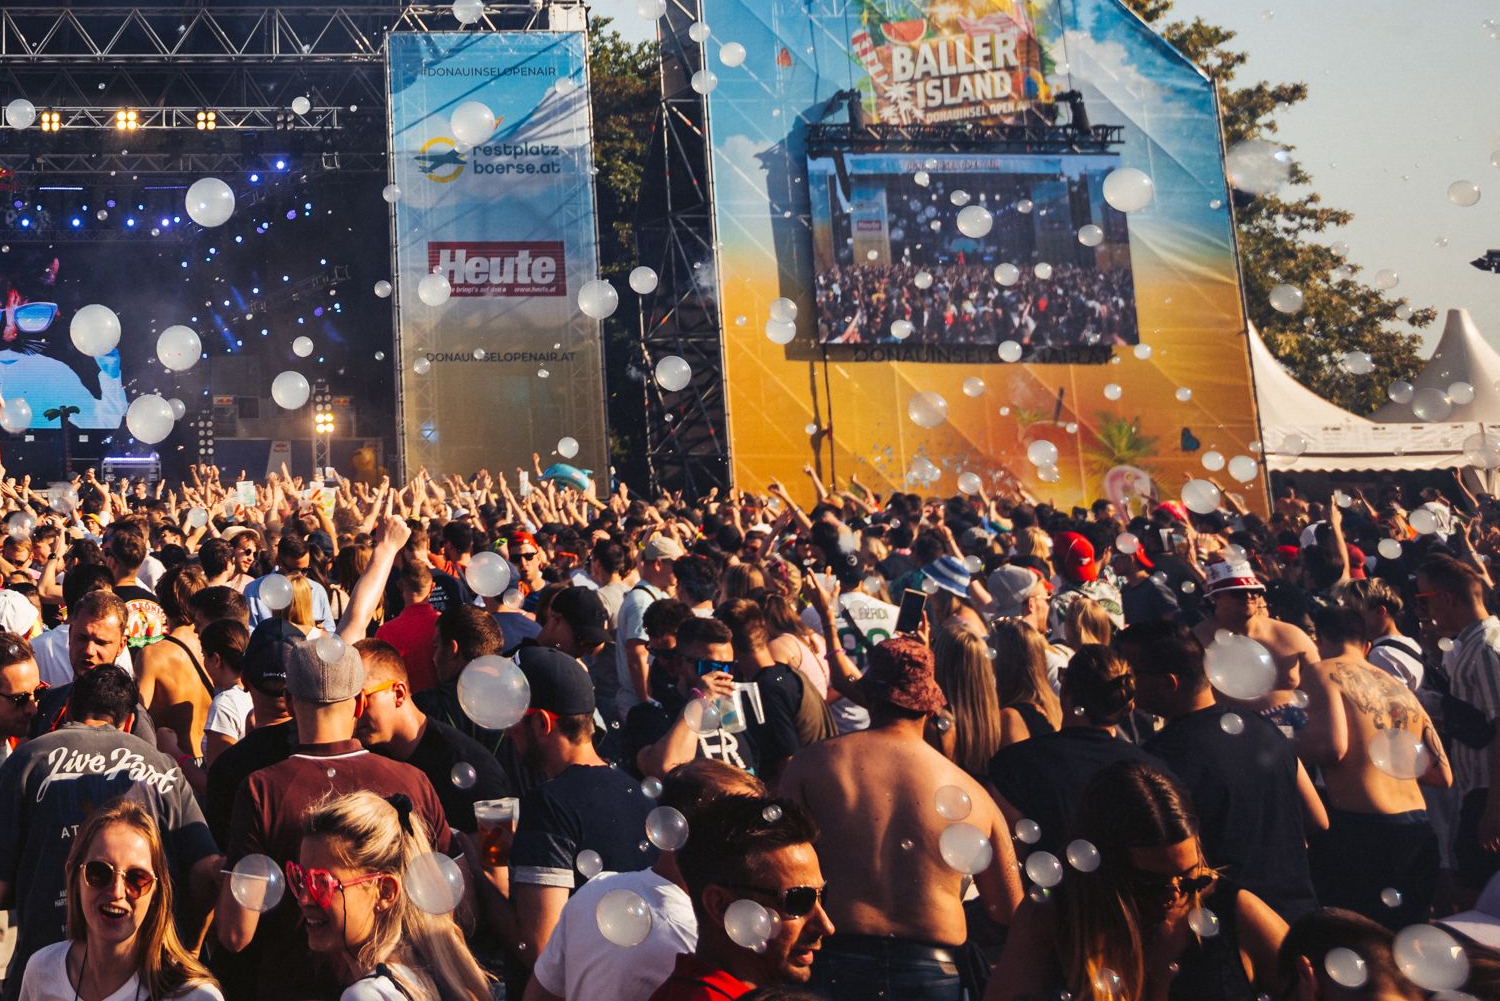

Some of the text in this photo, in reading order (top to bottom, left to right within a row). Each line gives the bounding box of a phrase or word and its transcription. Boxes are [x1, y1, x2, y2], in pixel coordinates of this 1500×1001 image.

[892, 33, 1019, 82] BALLER
[420, 67, 556, 77] #DONAUINSELOPENAIR
[917, 71, 1012, 109] ISLAND
[926, 105, 987, 124] DONAUINSEL
[990, 102, 1015, 115] OPEN
[473, 142, 560, 159] restplatz
[473, 161, 561, 174] boerse.at
[440, 249, 556, 284] Heute
[426, 352, 576, 362] DONAUISELOPENAIR.AT
[36, 747, 179, 803] Live Fast
[61, 824, 80, 839] AT
